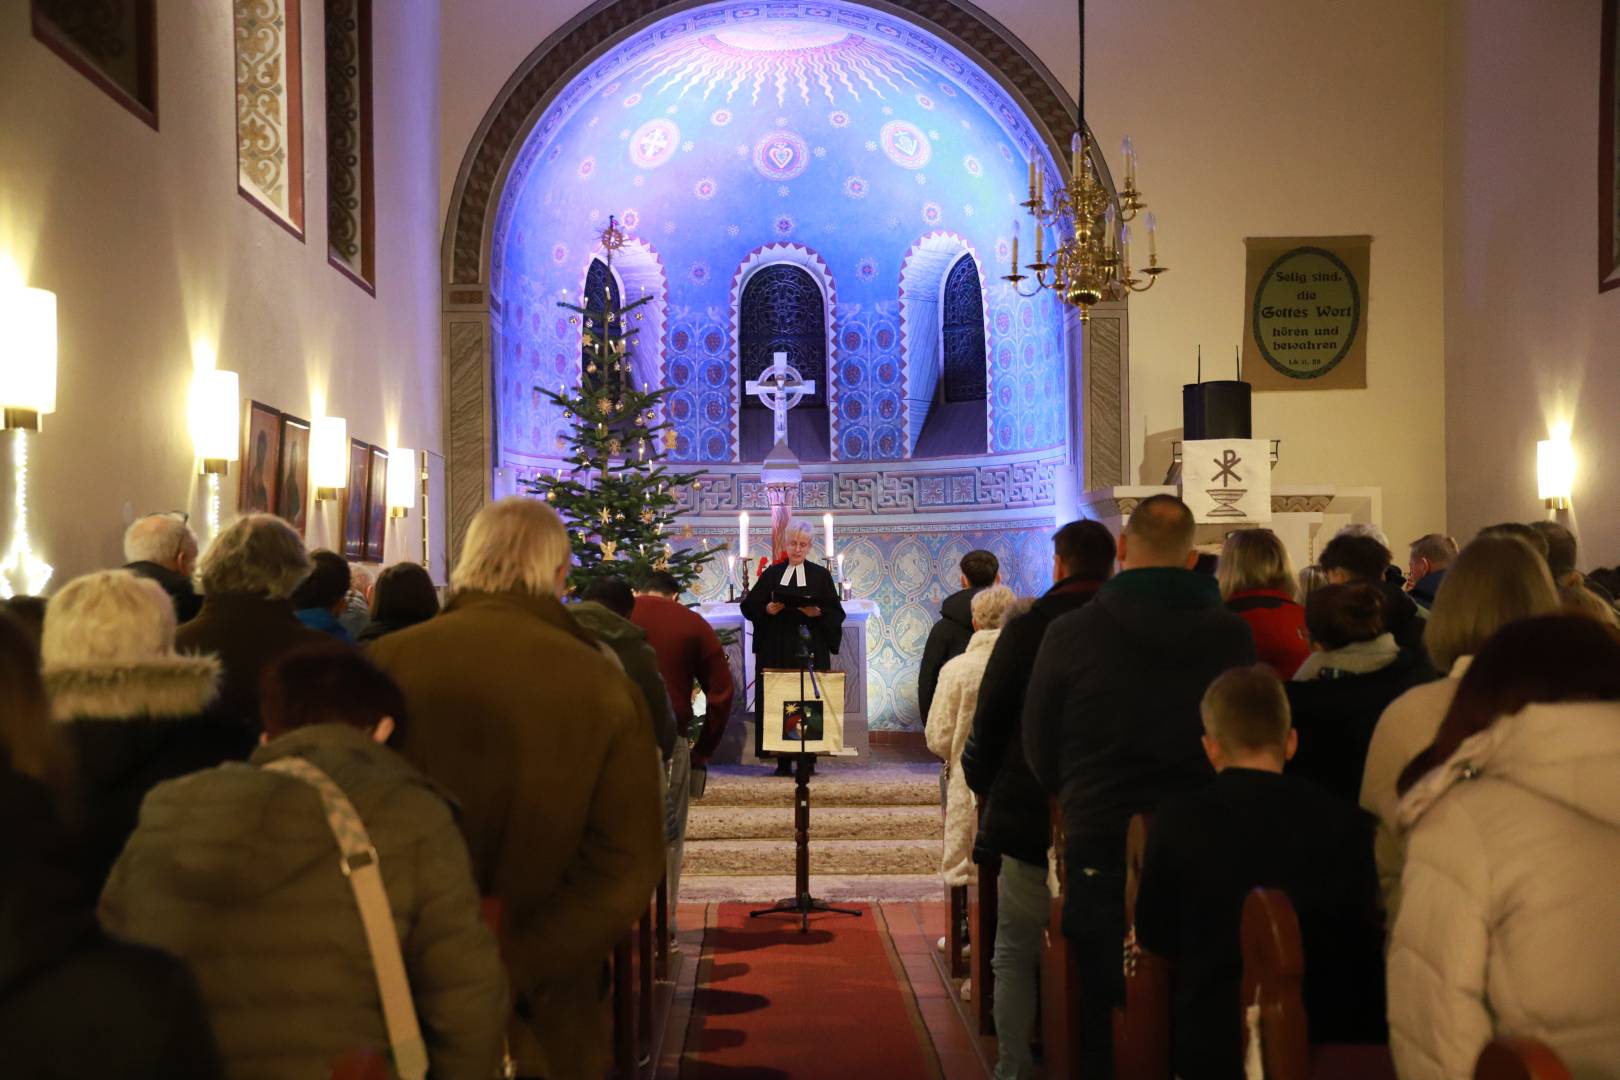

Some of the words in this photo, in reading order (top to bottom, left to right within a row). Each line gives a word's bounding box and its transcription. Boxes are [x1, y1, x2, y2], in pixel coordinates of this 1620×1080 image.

[1276, 272, 1307, 284] Selig
[1297, 290, 1316, 300] die
[1261, 306, 1308, 318] Gottes
[1316, 306, 1352, 317] Wort
[1272, 327, 1308, 337] hören
[1314, 326, 1339, 336] und
[1273, 340, 1337, 350] bewahren
